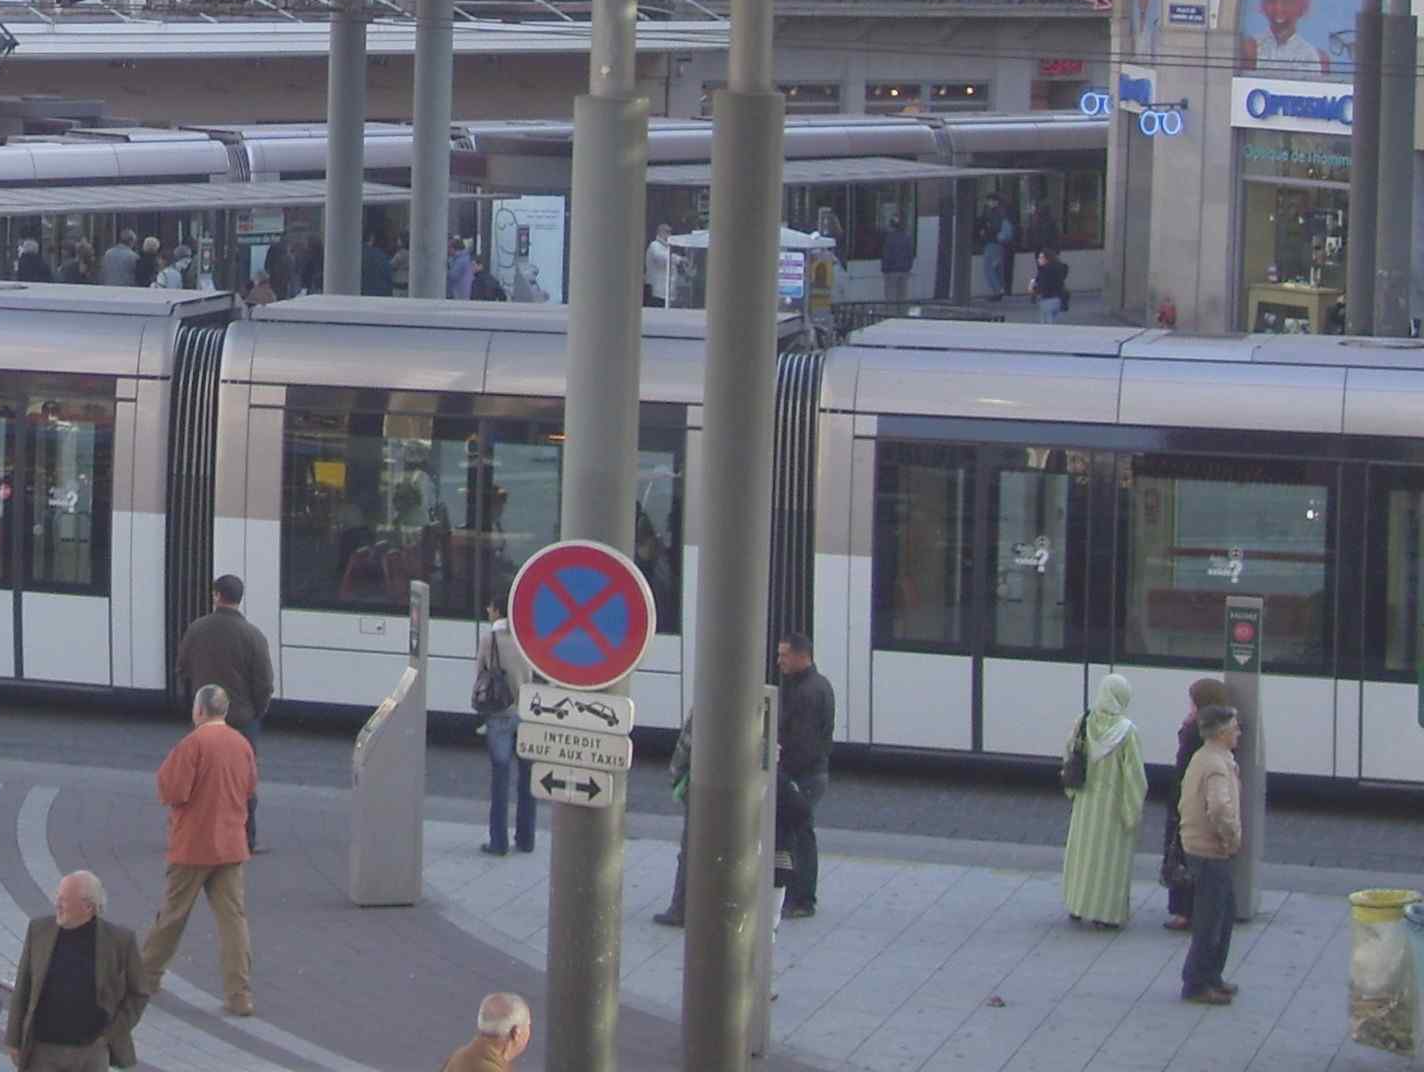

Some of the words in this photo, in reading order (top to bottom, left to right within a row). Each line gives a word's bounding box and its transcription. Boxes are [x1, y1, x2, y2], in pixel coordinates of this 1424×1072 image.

[543, 731, 602, 750] INTERDIT
[519, 741, 552, 756] SAUF
[559, 747, 584, 761] AUX
[591, 752, 625, 768] TAXIS
